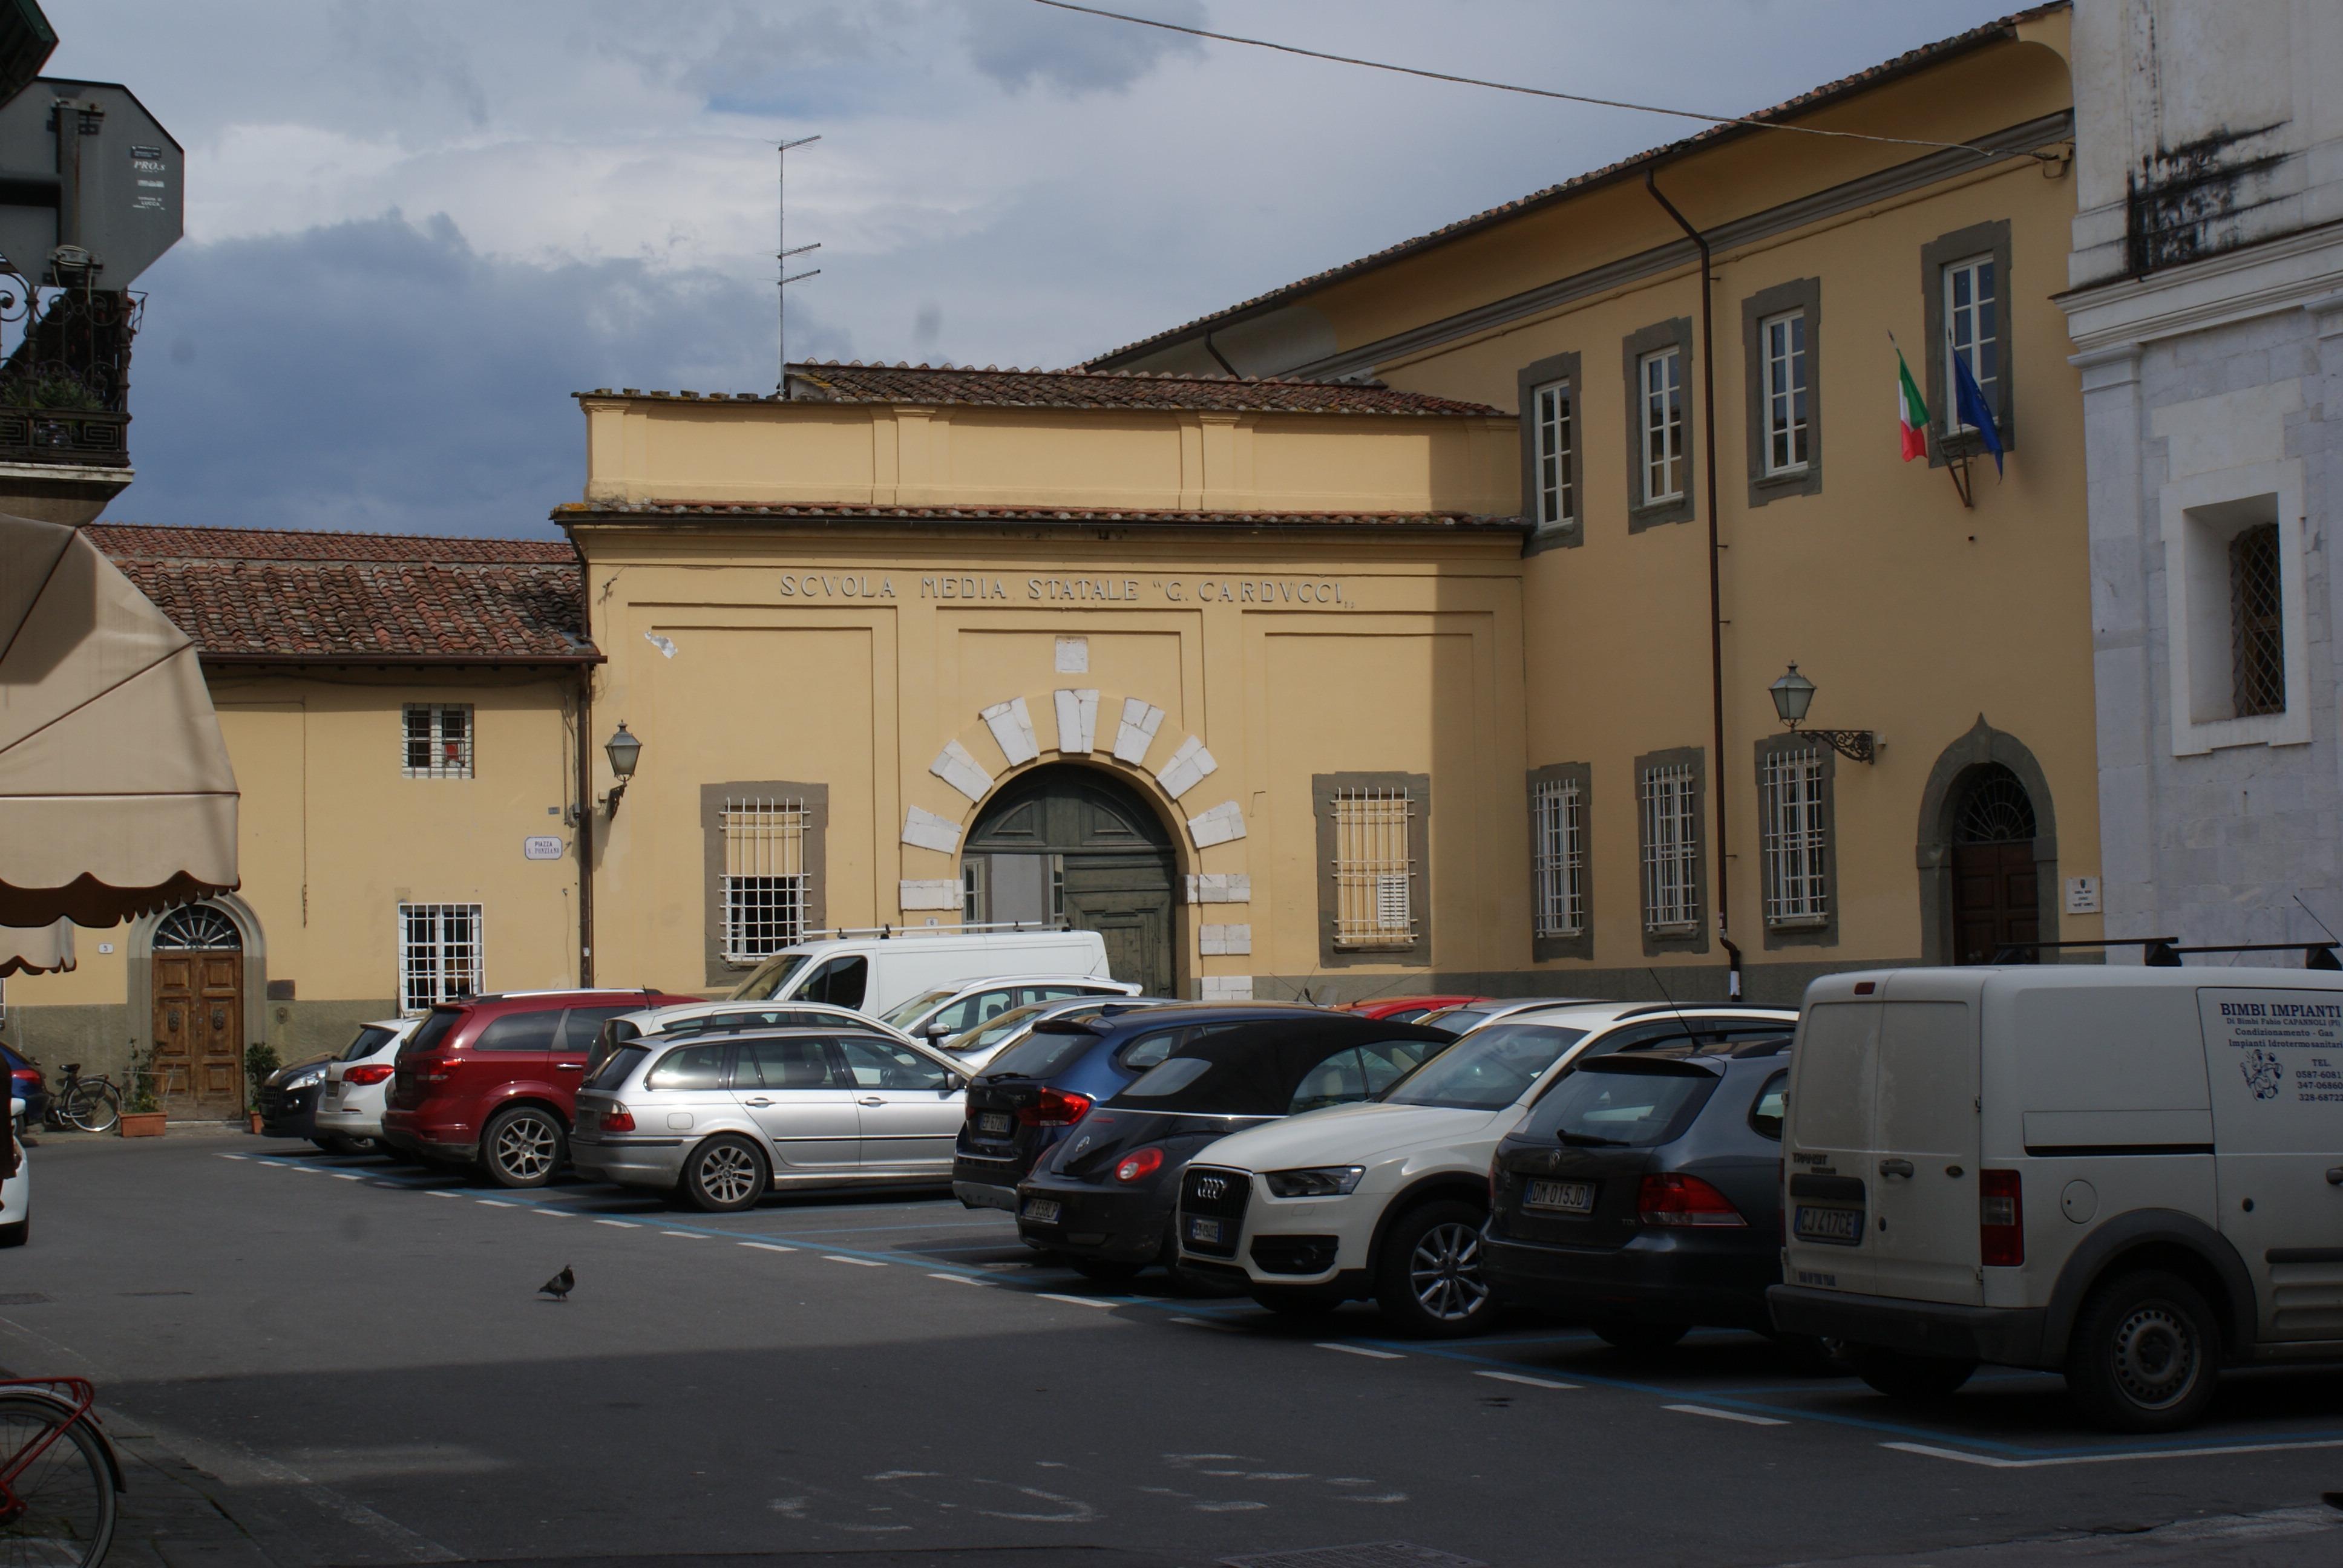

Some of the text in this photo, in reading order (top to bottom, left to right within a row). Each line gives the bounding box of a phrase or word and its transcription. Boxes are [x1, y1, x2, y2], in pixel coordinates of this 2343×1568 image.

[781, 576, 896, 597] SCVOLA
[921, 577, 1006, 599] MEDIA
[1028, 578, 1139, 600] STATALE
[2220, 1003, 2342, 1018] BIMBI IMPIANTI
[2229, 1039, 2266, 1049] Impianti
